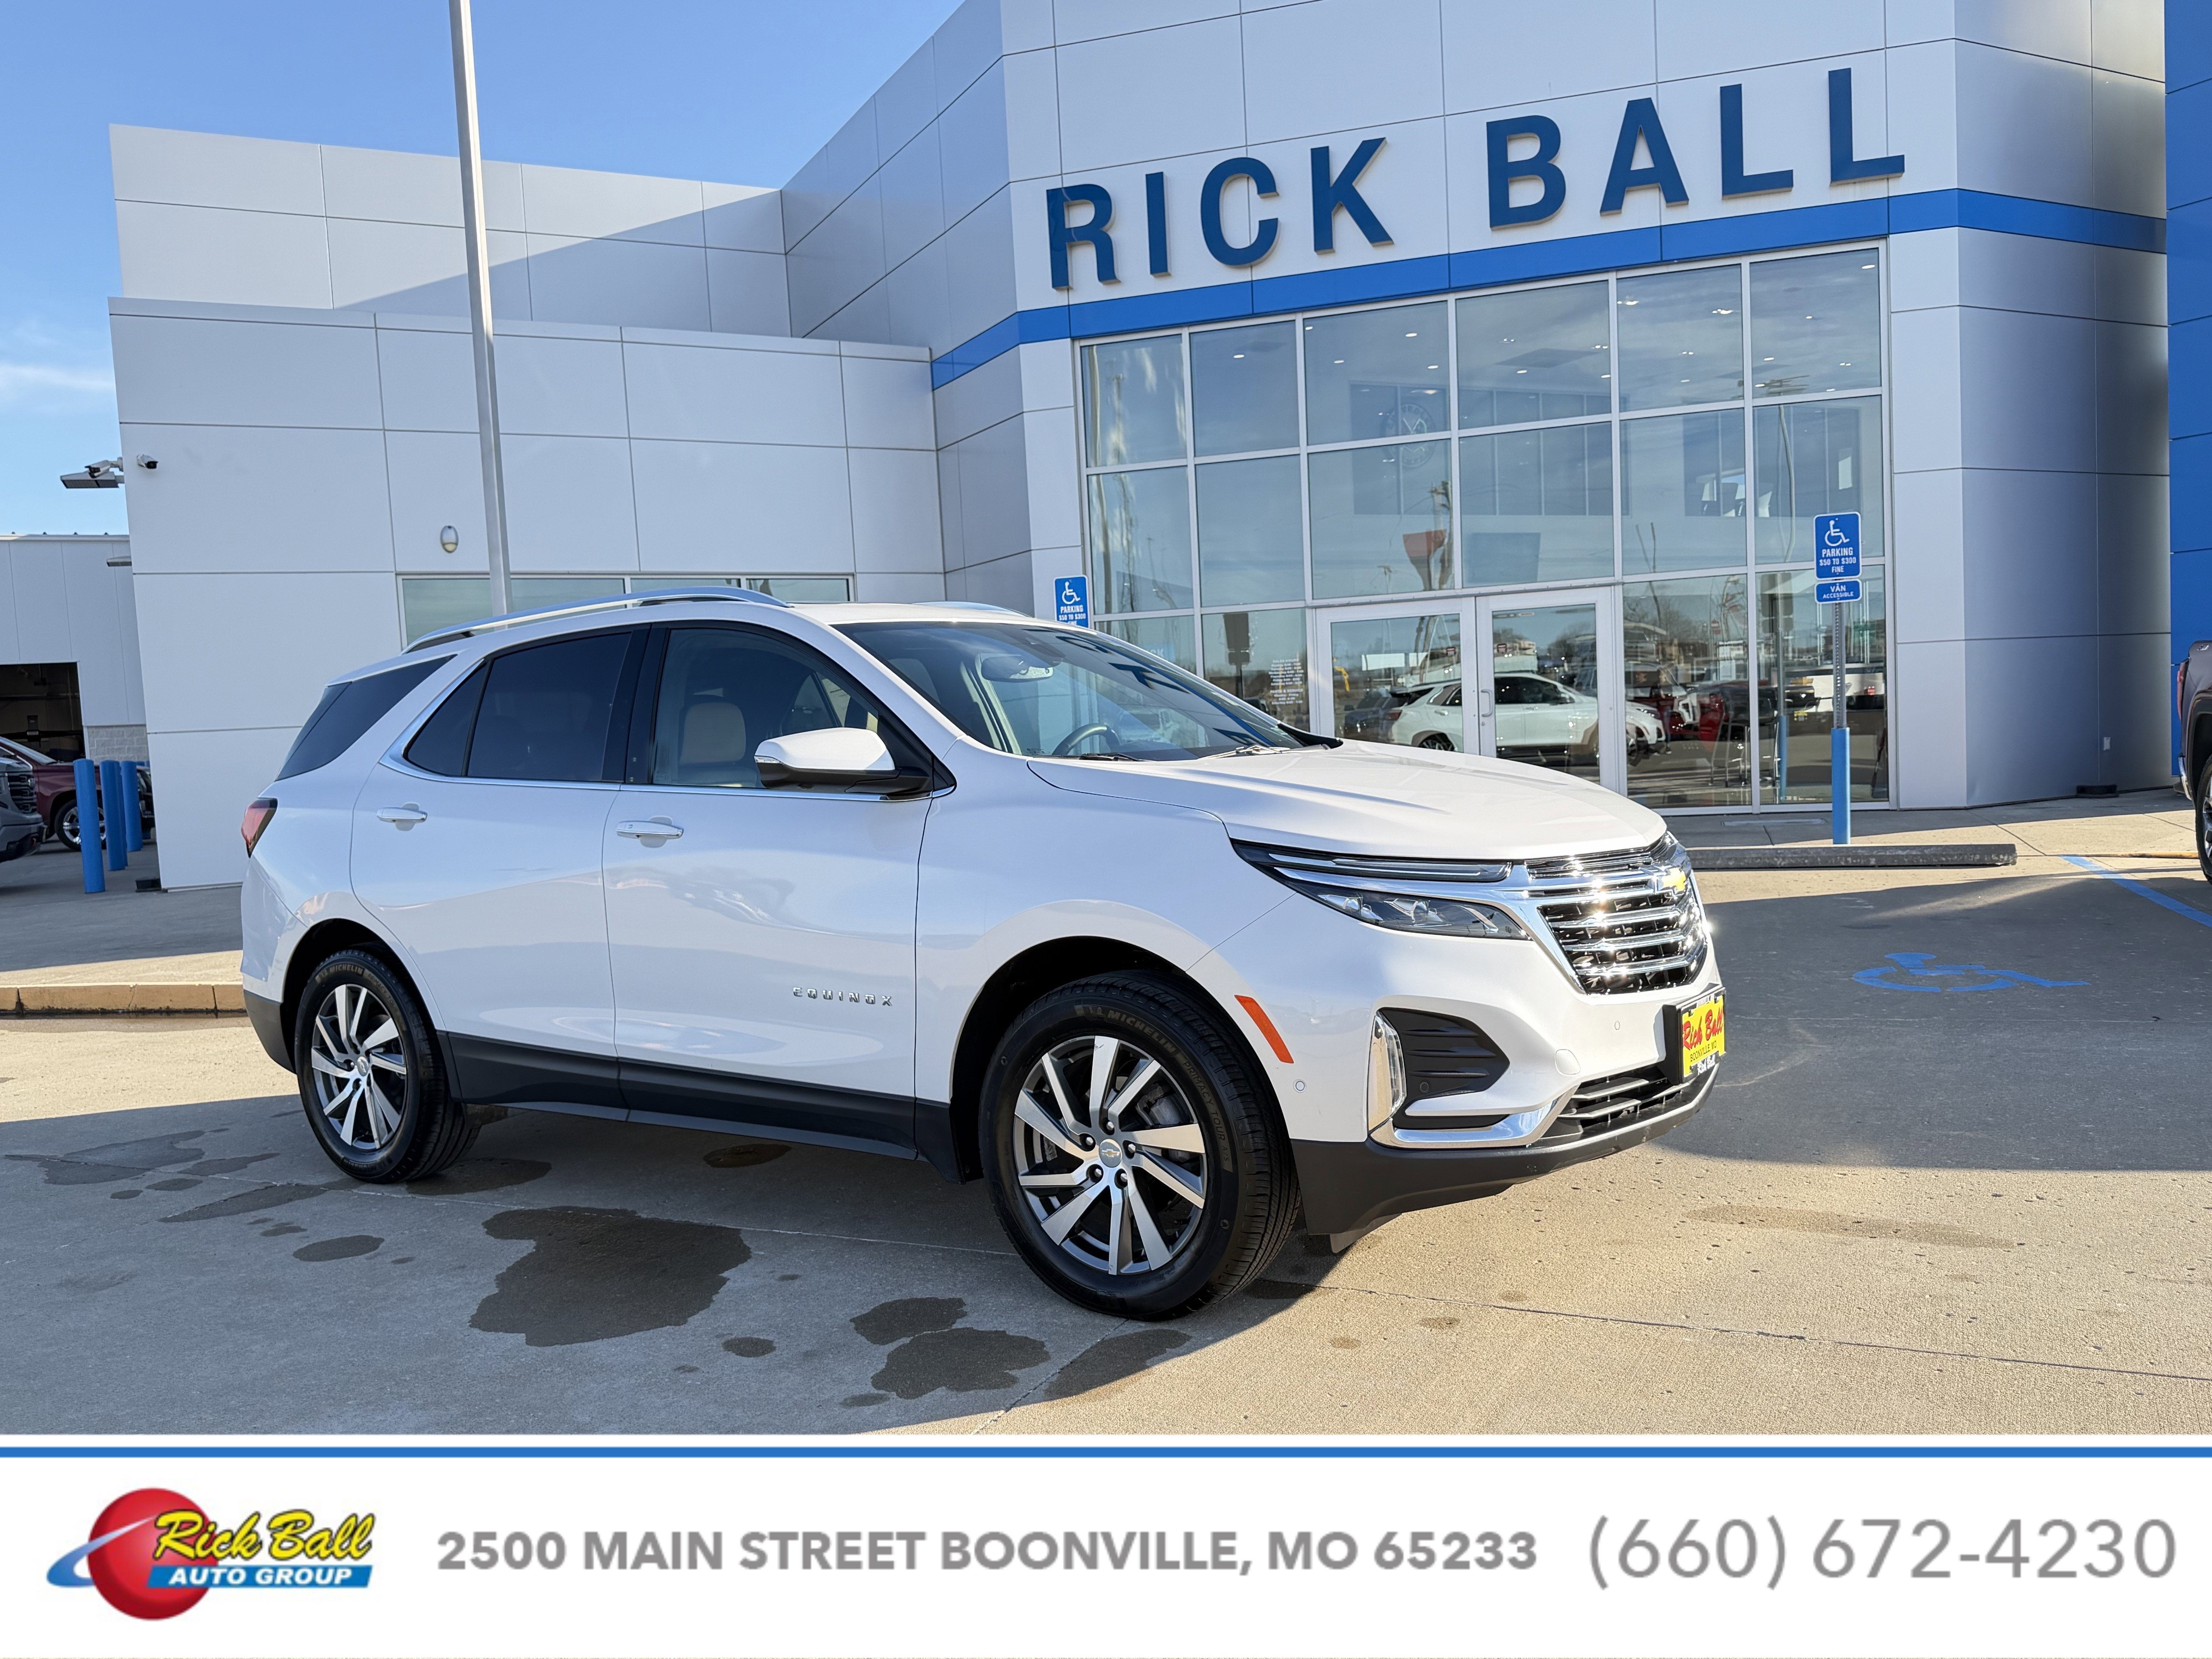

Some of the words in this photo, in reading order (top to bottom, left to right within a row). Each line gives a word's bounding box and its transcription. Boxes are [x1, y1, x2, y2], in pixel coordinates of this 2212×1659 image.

[1045, 137, 1394, 290] RICK
[1485, 67, 1906, 231] BALL
[1822, 547, 1853, 557] PARKING
[1060, 605, 1084, 614] PARKING
[330, 964, 364, 975] MICHELIN
[793, 987, 893, 1006] EQUINOX
[1683, 1015, 1703, 1051] Rick
[1705, 1006, 1723, 1041] Ball
[1107, 1010, 1177, 1054] MICHELIN
[1183, 1061, 1214, 1106] PRIMACY
[1210, 1110, 1225, 1141] TOUR
